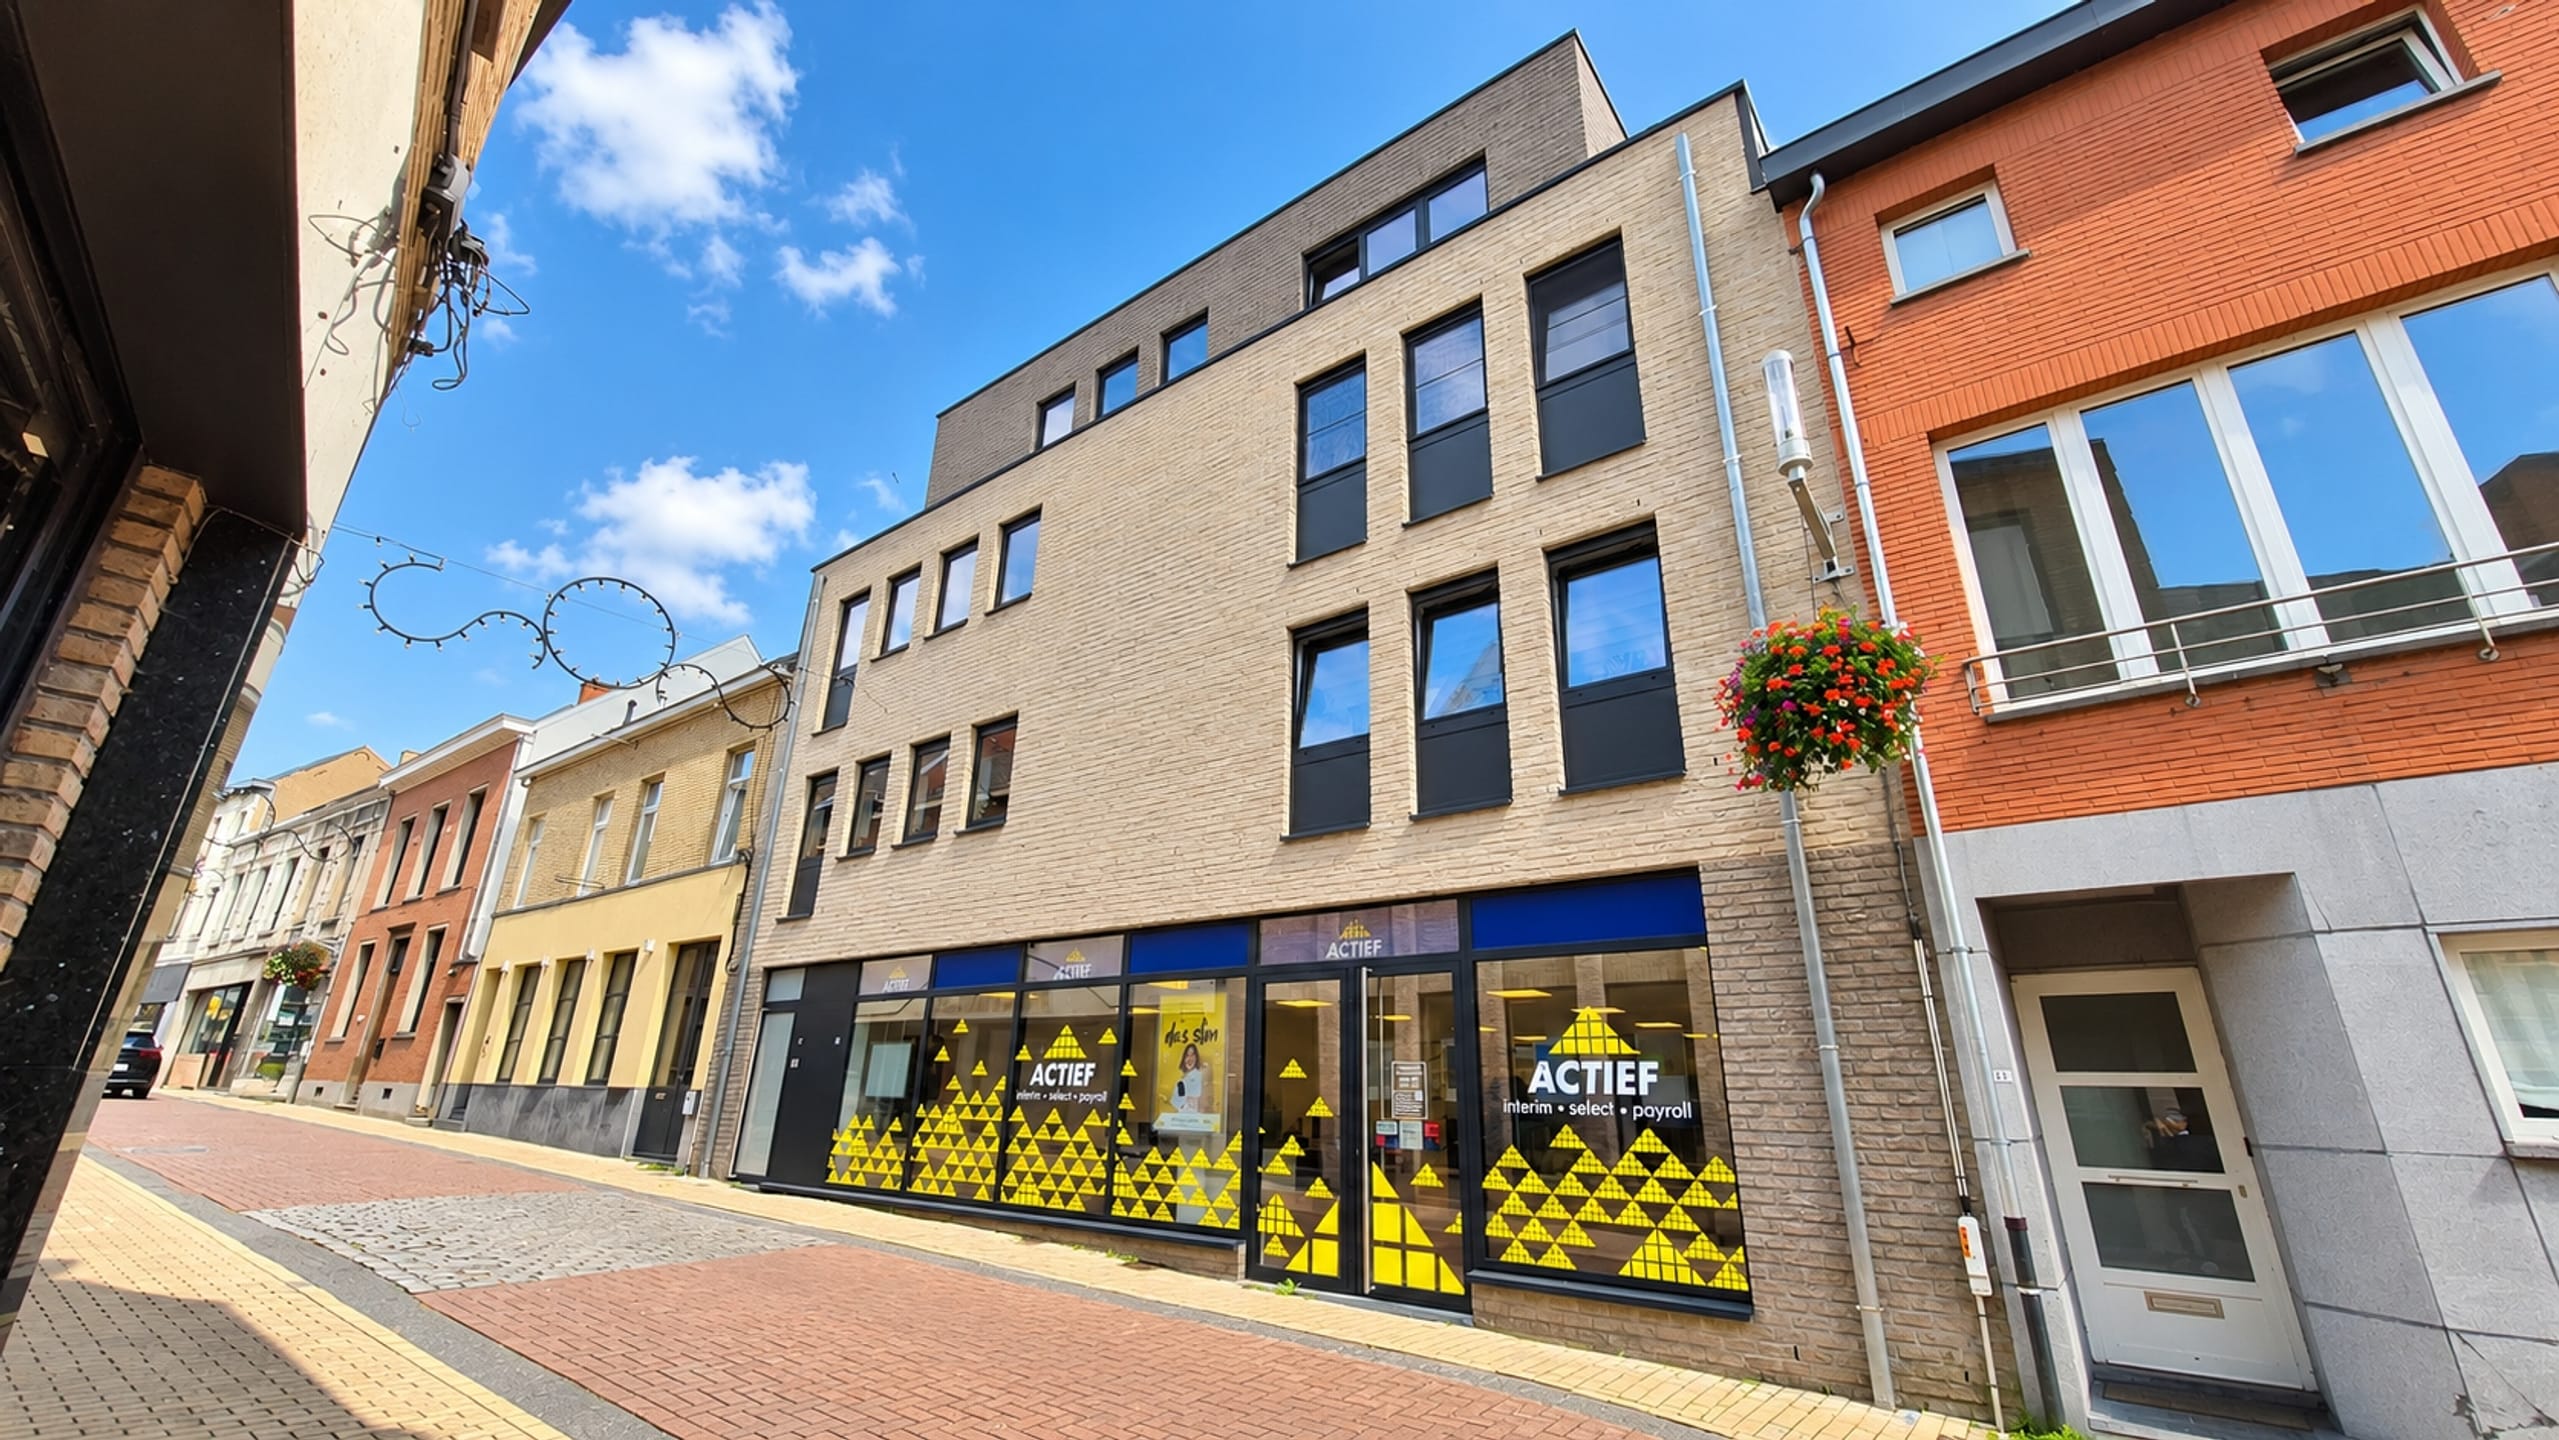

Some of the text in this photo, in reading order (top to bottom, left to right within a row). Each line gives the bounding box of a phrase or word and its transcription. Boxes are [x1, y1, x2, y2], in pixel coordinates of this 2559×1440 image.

[1325, 939, 1382, 959] ACTIEF
[1028, 1062, 1096, 1086] ACTIEF
[1527, 1060, 1659, 1096] ACTIEF
[1077, 1090, 1108, 1104] payroll
[1502, 1098, 1693, 1122] interim select payroll
